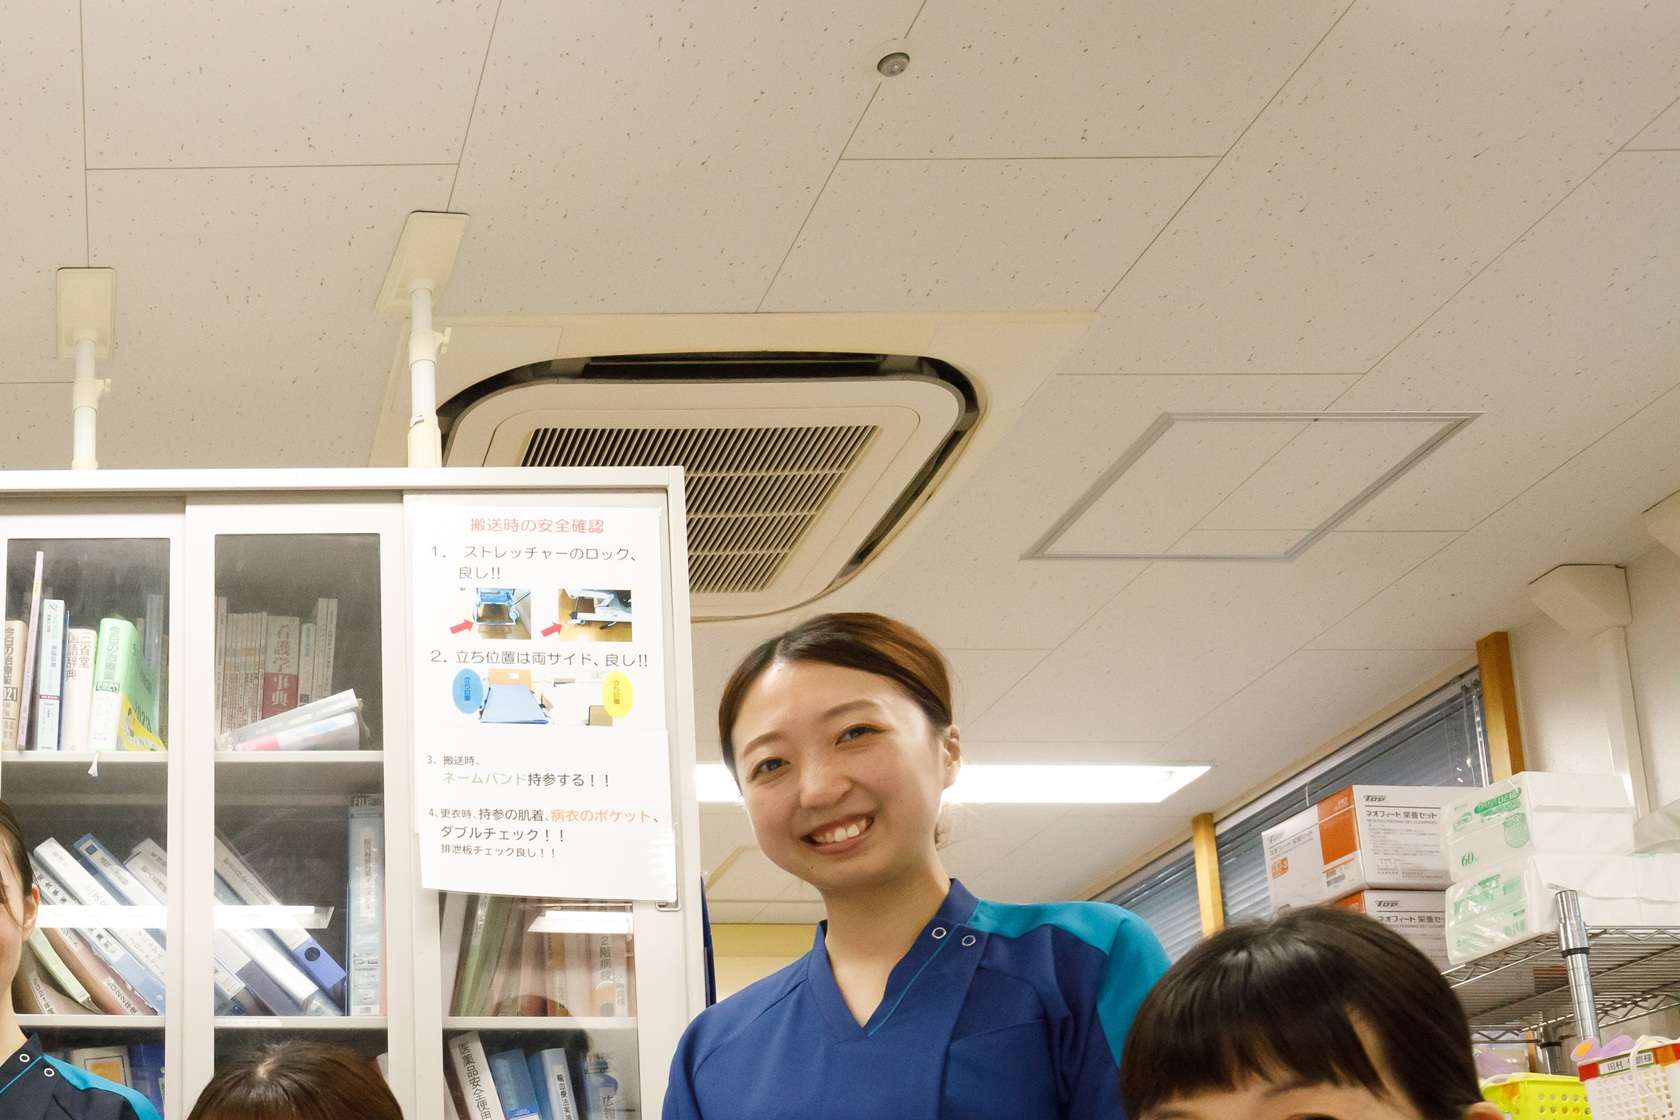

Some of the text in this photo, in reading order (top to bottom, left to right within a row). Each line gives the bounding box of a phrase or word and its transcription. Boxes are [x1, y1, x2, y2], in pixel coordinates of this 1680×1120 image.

[471, 518, 604, 533] 搬送時の安全確認
[465, 545, 637, 561] ストレッチャーのロック、
